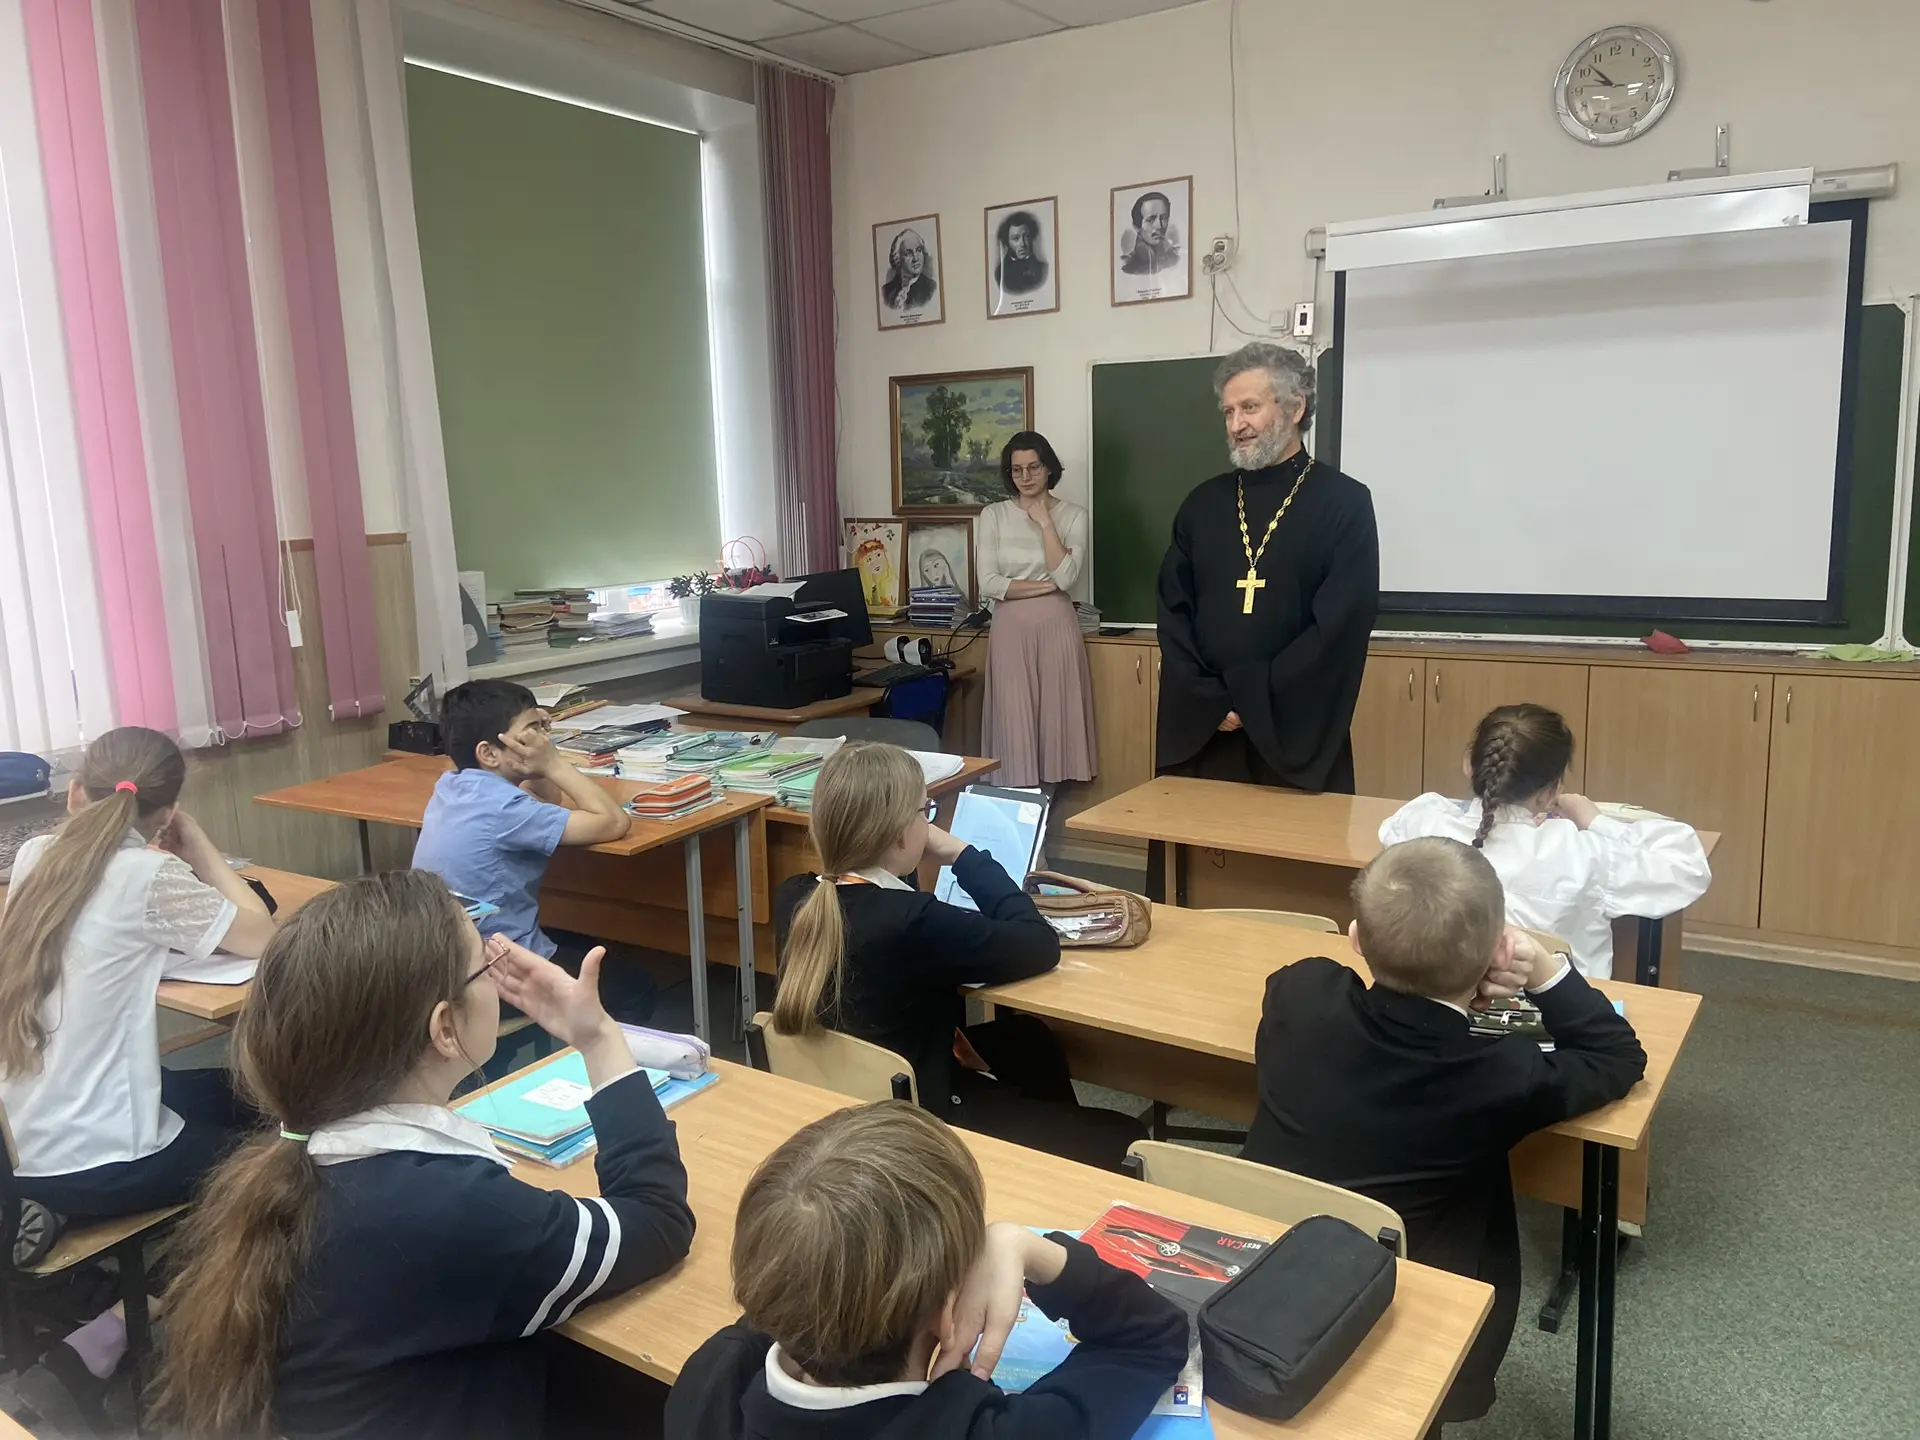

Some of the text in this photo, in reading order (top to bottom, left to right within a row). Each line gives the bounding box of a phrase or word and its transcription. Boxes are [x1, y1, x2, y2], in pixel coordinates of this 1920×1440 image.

[1609, 44, 1622, 57] 12
[1594, 53, 1602, 63] 11
[1643, 57, 1652, 68] 2
[1579, 67, 1591, 79] 10
[1647, 74, 1656, 86] 3
[1574, 86, 1584, 97] 9
[1640, 91, 1649, 102] 4
[1593, 112, 1601, 123] 7
[1630, 106, 1638, 118] 5
[1609, 115, 1618, 126] 6
